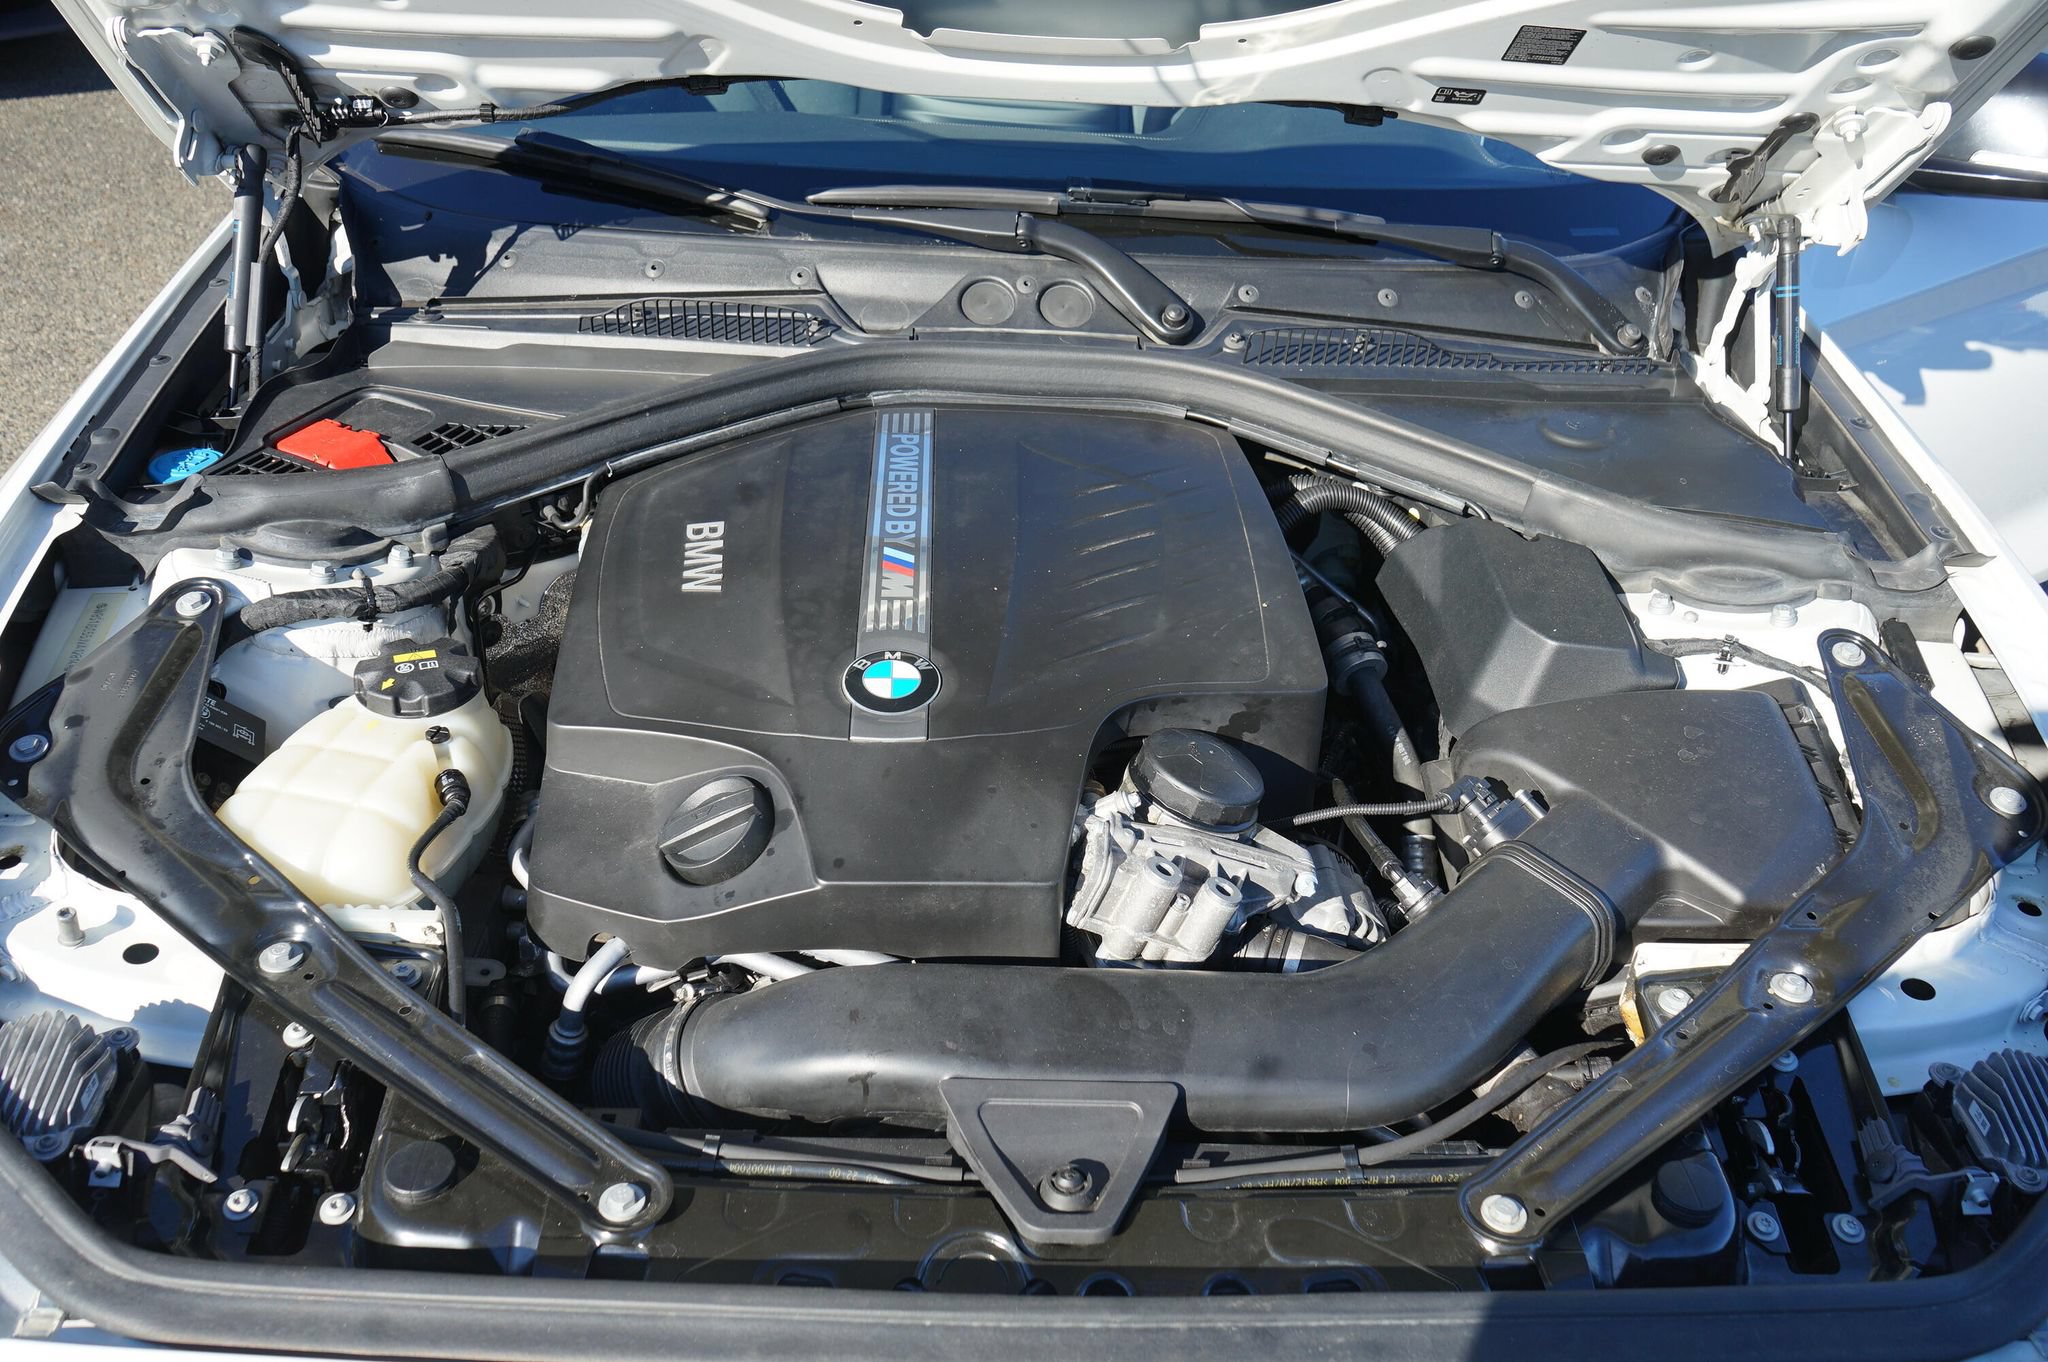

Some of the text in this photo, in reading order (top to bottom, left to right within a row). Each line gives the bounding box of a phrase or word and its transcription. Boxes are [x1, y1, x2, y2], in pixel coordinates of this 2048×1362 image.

[886, 432, 920, 517] POWERED
[681, 520, 725, 592] BMW
[883, 520, 916, 548] BY
[853, 651, 933, 671] BMW
